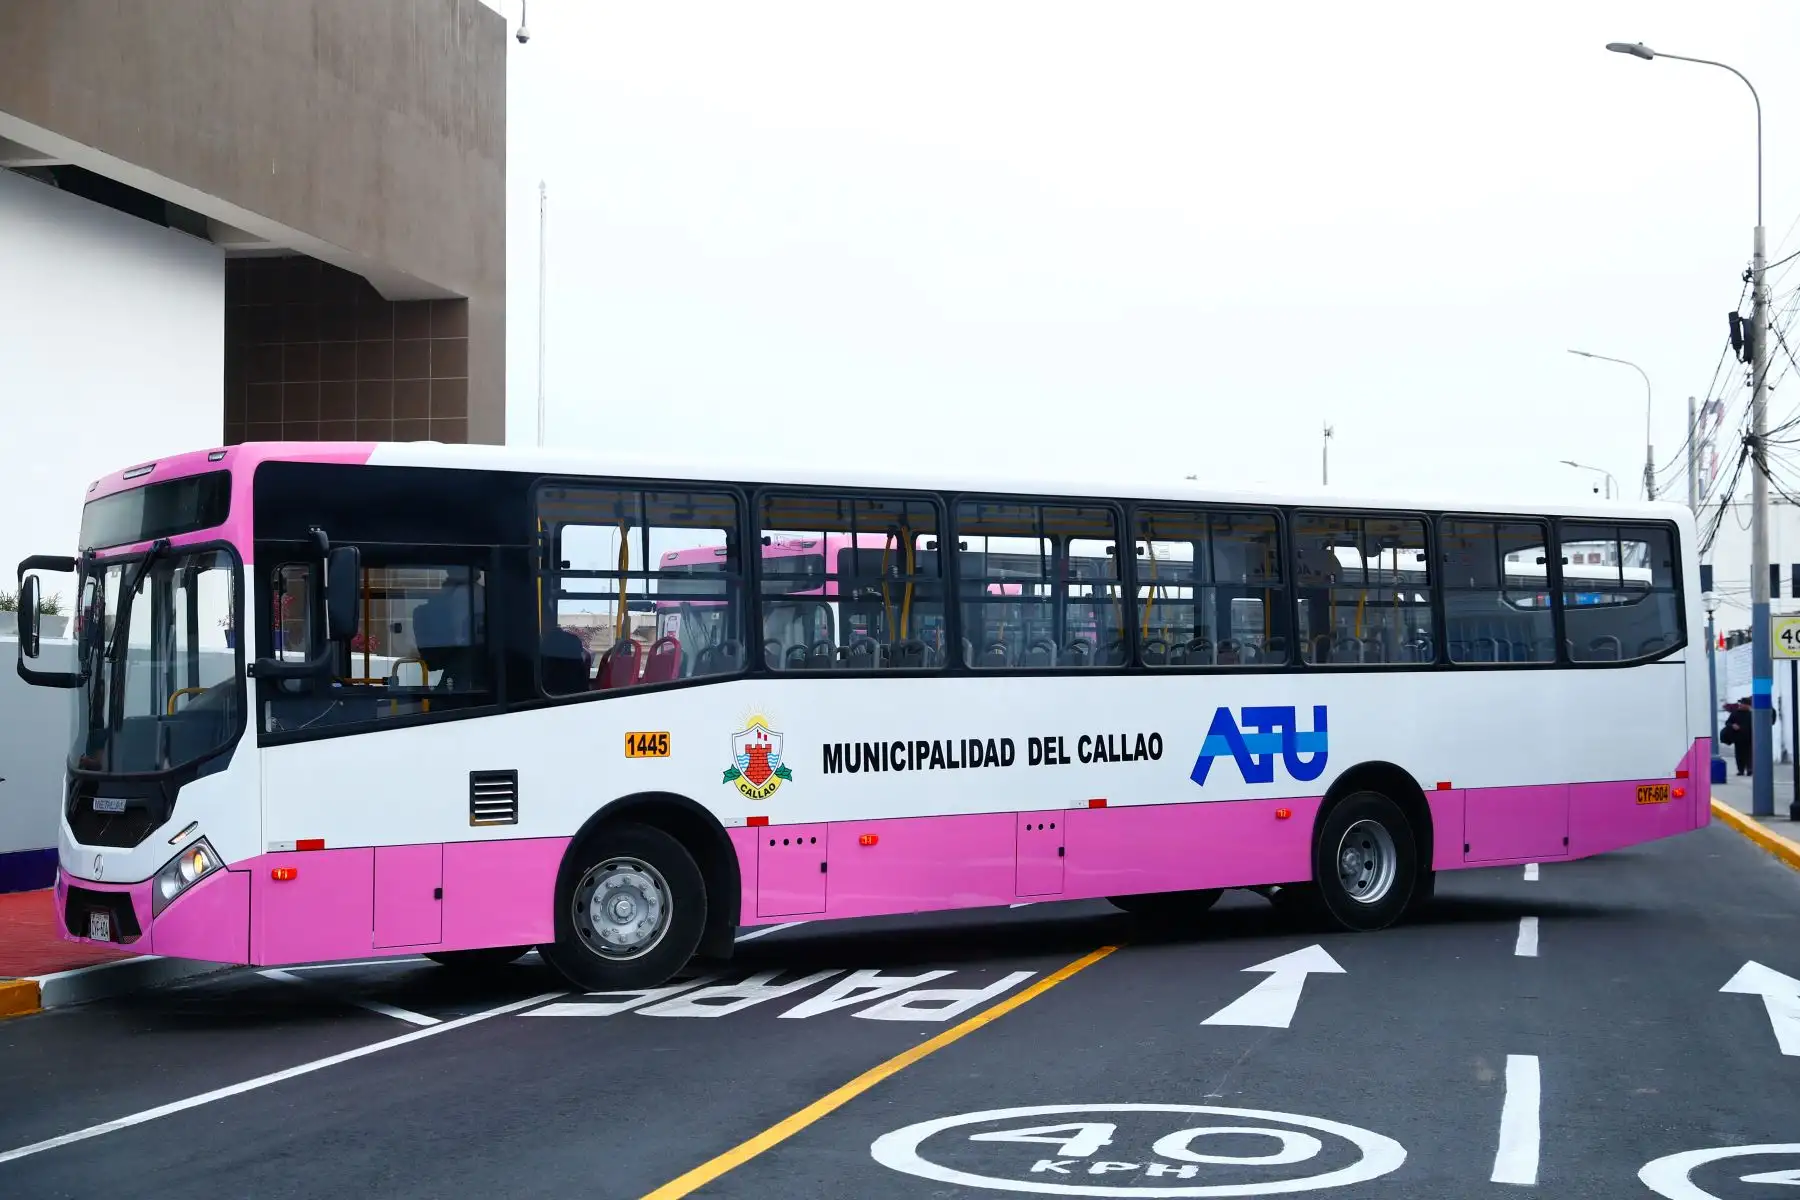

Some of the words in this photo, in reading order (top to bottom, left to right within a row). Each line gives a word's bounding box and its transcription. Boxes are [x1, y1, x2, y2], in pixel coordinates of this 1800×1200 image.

[627, 733, 668, 756] 1445
[822, 737, 1015, 774] MUNICIPALIDAD
[1028, 736, 1071, 766] DEL
[1077, 732, 1163, 763] CALLAO
[1189, 704, 1328, 787] ATU
[740, 783, 776, 799] CALLAO
[1637, 785, 1668, 802] CYF-604
[968, 1122, 1322, 1165] 40
[1029, 1159, 1199, 1179] KPH
